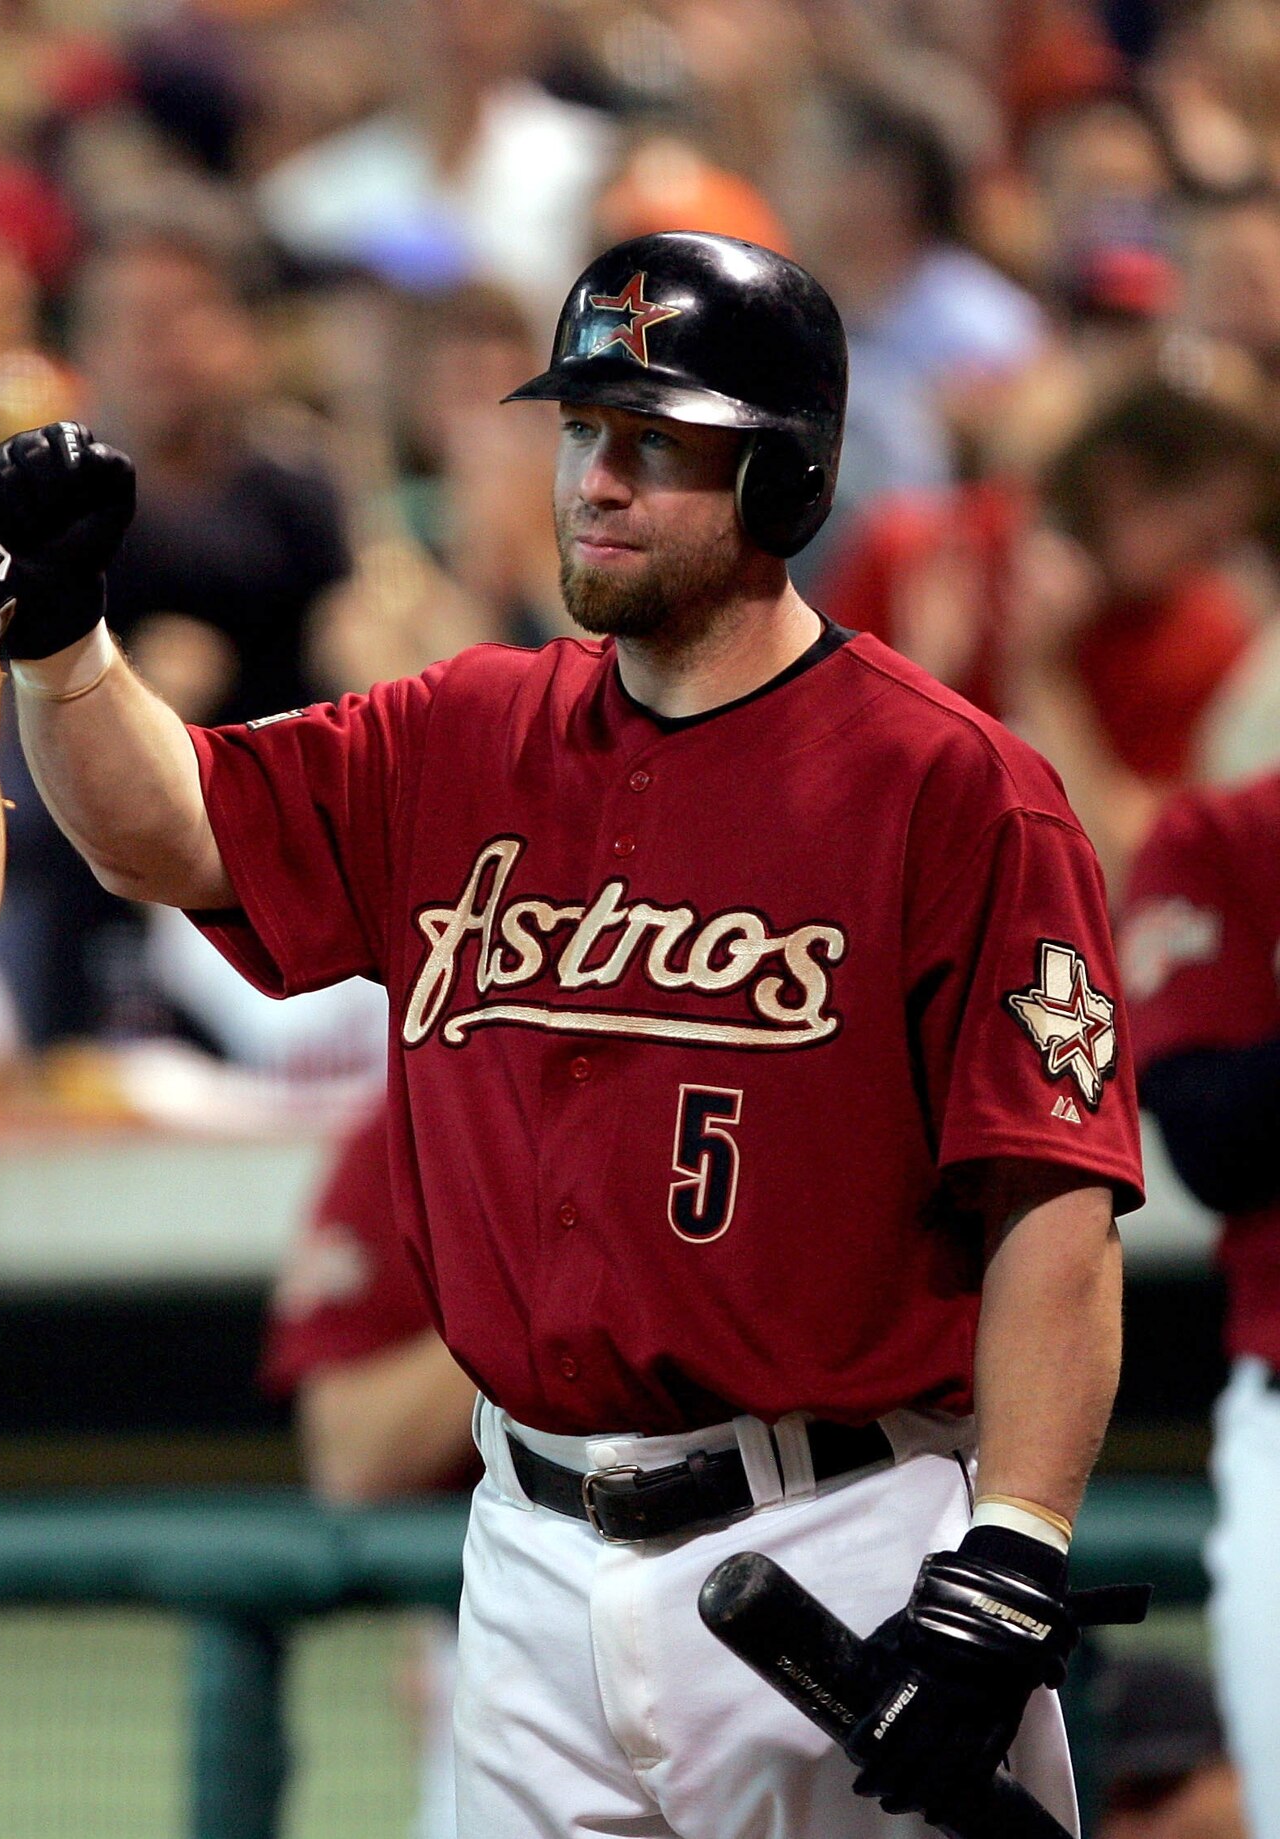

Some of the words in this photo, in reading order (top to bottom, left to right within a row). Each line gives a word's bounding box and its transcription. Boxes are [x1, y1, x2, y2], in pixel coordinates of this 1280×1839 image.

[61, 422, 81, 462] WELL
[401, 836, 847, 1047] Astros
[666, 1083, 744, 1245] 5
[811, 1686, 858, 1725] OUSTON
[872, 1682, 919, 1741] BAGWELL
